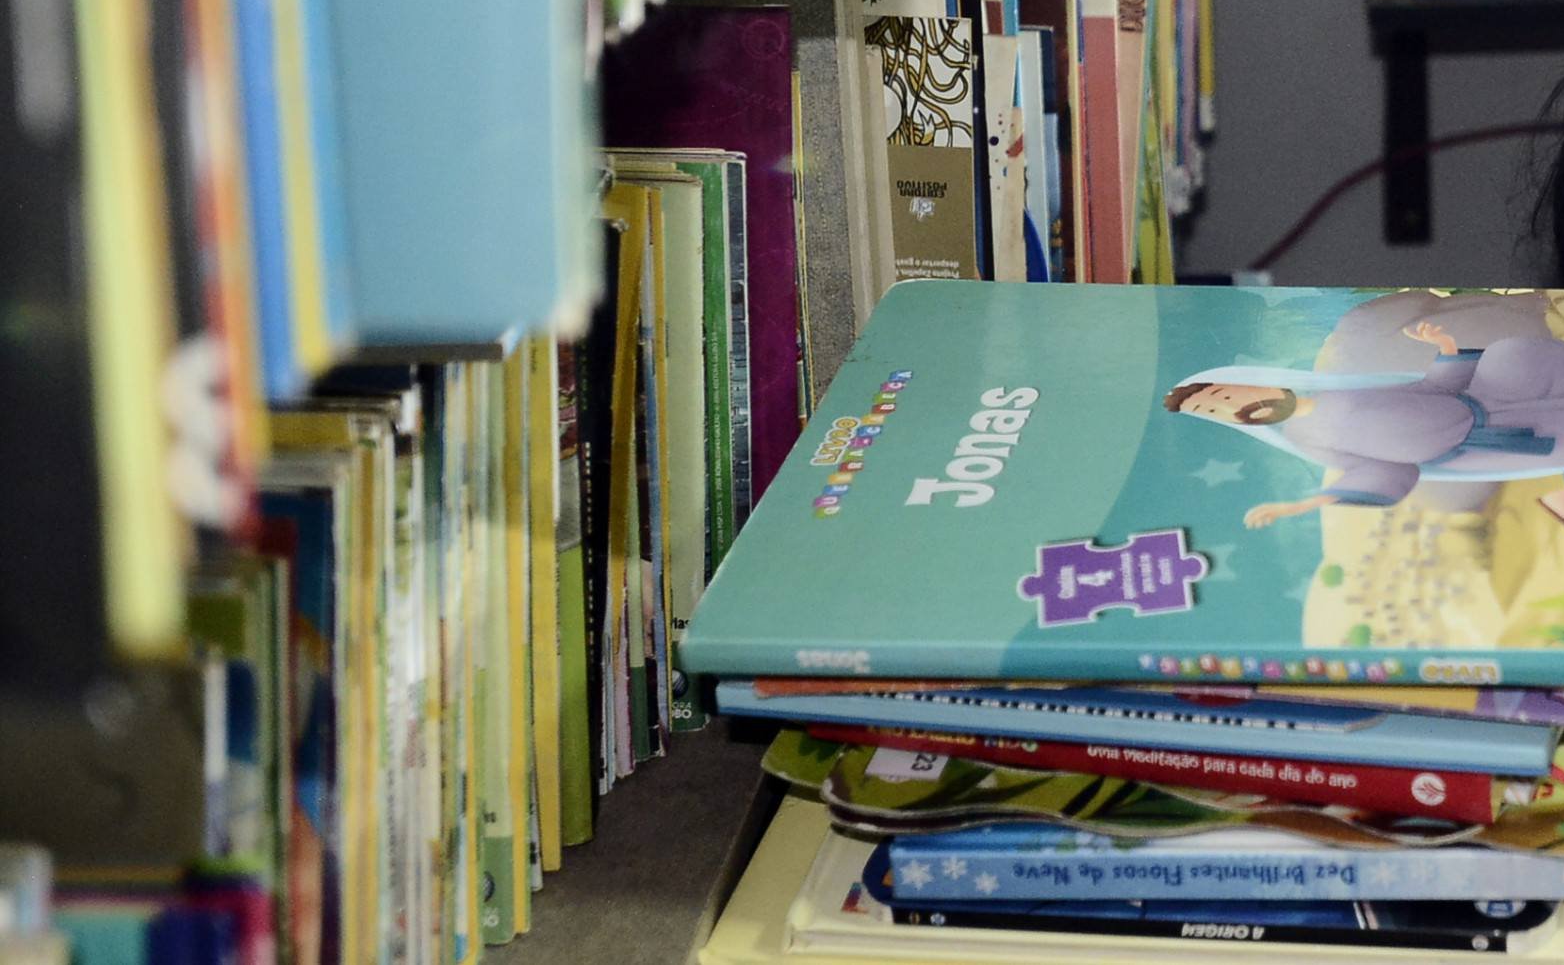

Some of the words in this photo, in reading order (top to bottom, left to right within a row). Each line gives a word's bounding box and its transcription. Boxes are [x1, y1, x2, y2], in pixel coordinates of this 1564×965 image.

[896, 180, 947, 191] POSITIVO
[810, 416, 861, 466] LIVRO
[904, 386, 1039, 507] Jonas
[1203, 756, 1236, 774] para
[1239, 761, 1274, 780] cada
[1278, 763, 1301, 783] dia
[1305, 766, 1324, 784] do
[1328, 774, 1357, 789] ano
[1013, 862, 1071, 885] Neve
[1078, 863, 1104, 885] de
[1113, 863, 1182, 886] Flocos
[1189, 863, 1306, 885] Brilhantes
[1316, 863, 1357, 884] Dez
[1180, 923, 1250, 940] ORIGEM
[1252, 926, 1265, 940] A
